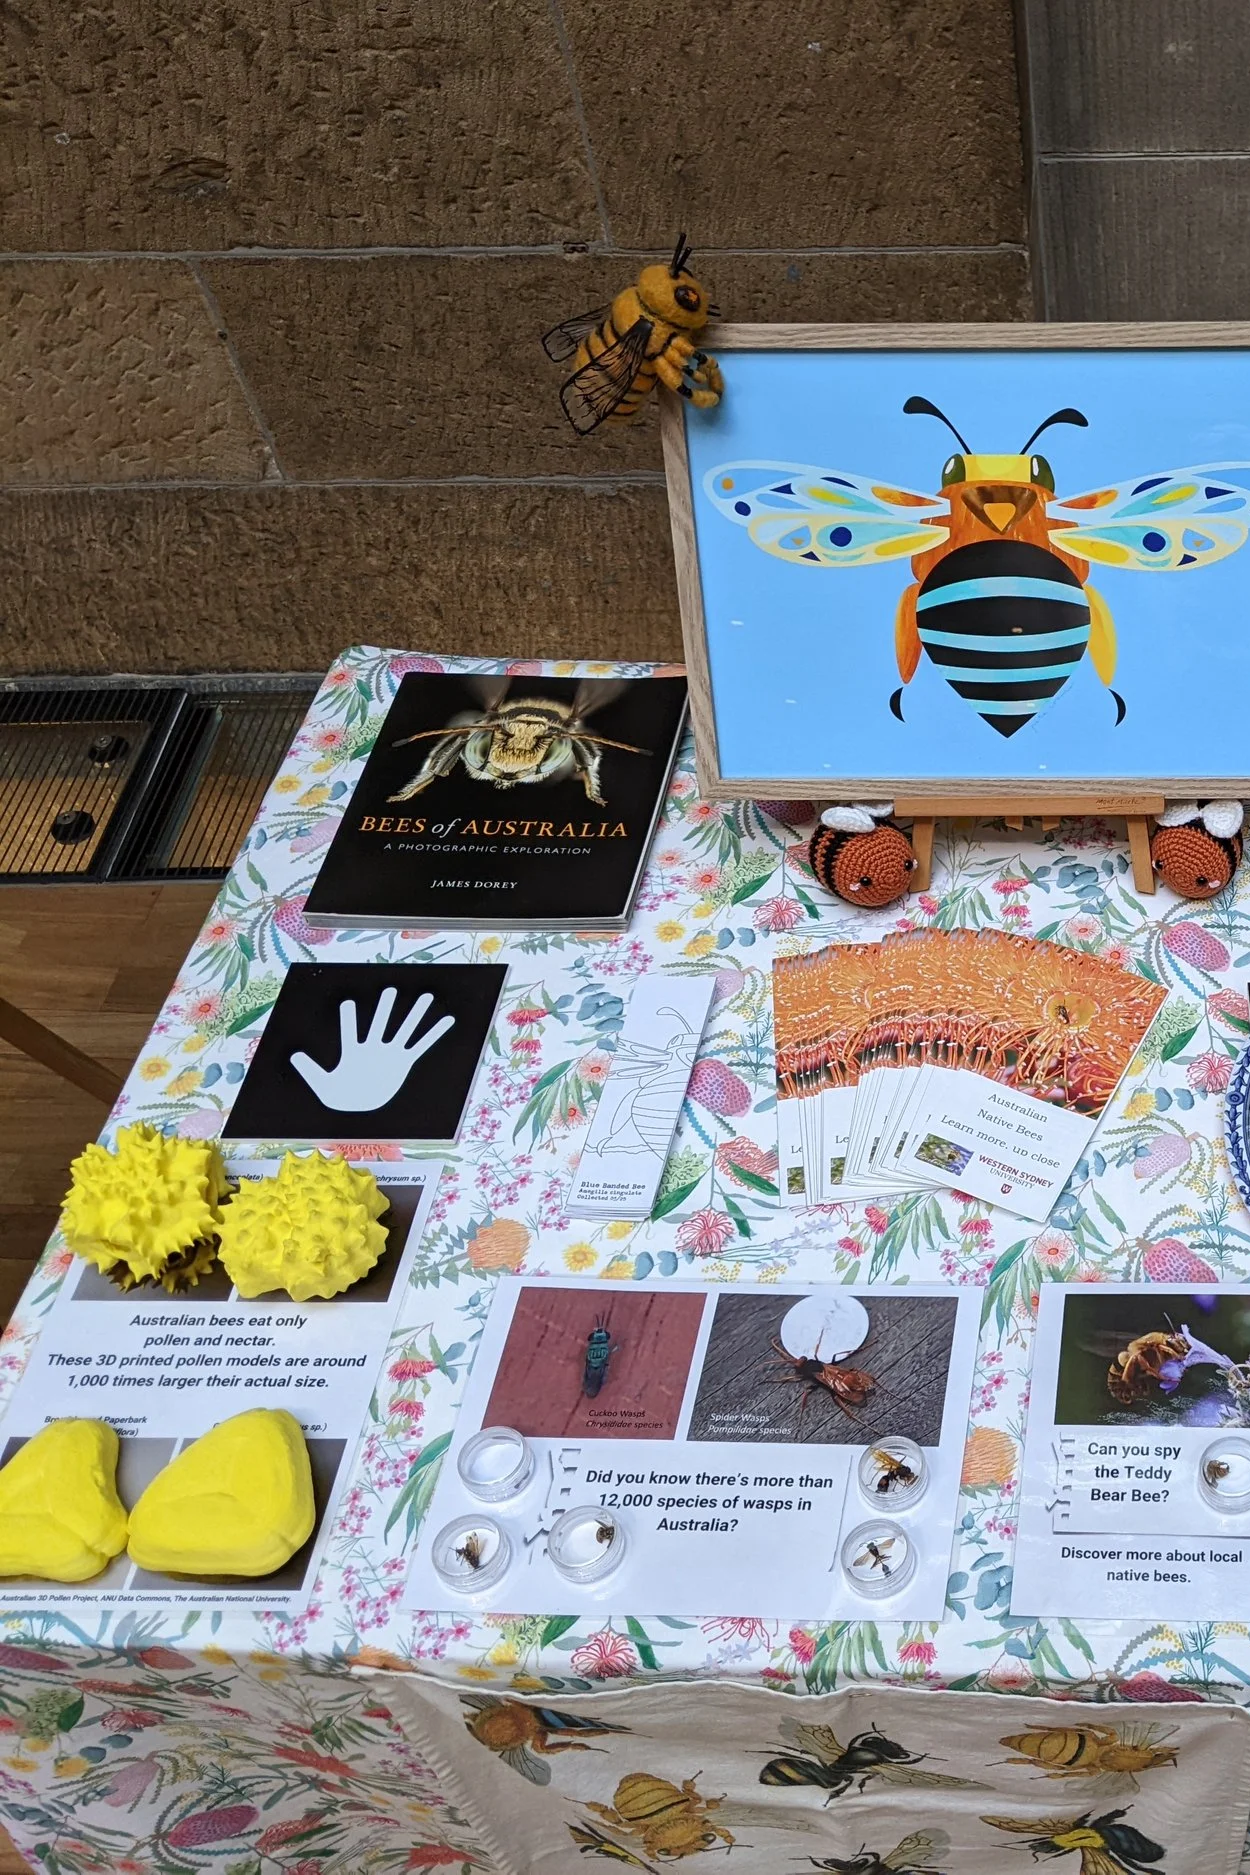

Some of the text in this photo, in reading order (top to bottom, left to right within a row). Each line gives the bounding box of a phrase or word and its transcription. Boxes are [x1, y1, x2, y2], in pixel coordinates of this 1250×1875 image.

[359, 817, 628, 838] BEES of AUSTRALIA
[398, 844, 591, 854] PHOTOGRAPHIC EXPLORATION
[431, 880, 518, 889] JAMES DOREY
[988, 1094, 1048, 1123] Australian
[977, 1109, 1043, 1141] Native Bees
[941, 1115, 1060, 1168] Learn close
[979, 1155, 1054, 1188] WESTERN SYDNEY
[990, 1168, 1034, 1189] UNIVERSITY
[130, 1315, 308, 1330] Australian bees eat only
[144, 1335, 275, 1349] pollen and nectar.
[48, 1354, 366, 1369] These 3D printed pollen models are around
[67, 1375, 329, 1389] 1,000 times larger their actual size.
[104, 1416, 147, 1425] Paperbark
[620, 1410, 645, 1418] Wasps
[710, 1413, 769, 1422] Spider Wasps
[1088, 1443, 1181, 1460] Can you spy
[586, 1471, 833, 1488] Did you know there's more than
[1095, 1466, 1172, 1481] the Teddy
[599, 1494, 812, 1512] 12,000 species of wasps in
[1091, 1489, 1169, 1502] Bear Bee?
[657, 1518, 738, 1531] Australia?
[1061, 1547, 1242, 1562] Discover more about local
[1107, 1569, 1191, 1582] native bees.
